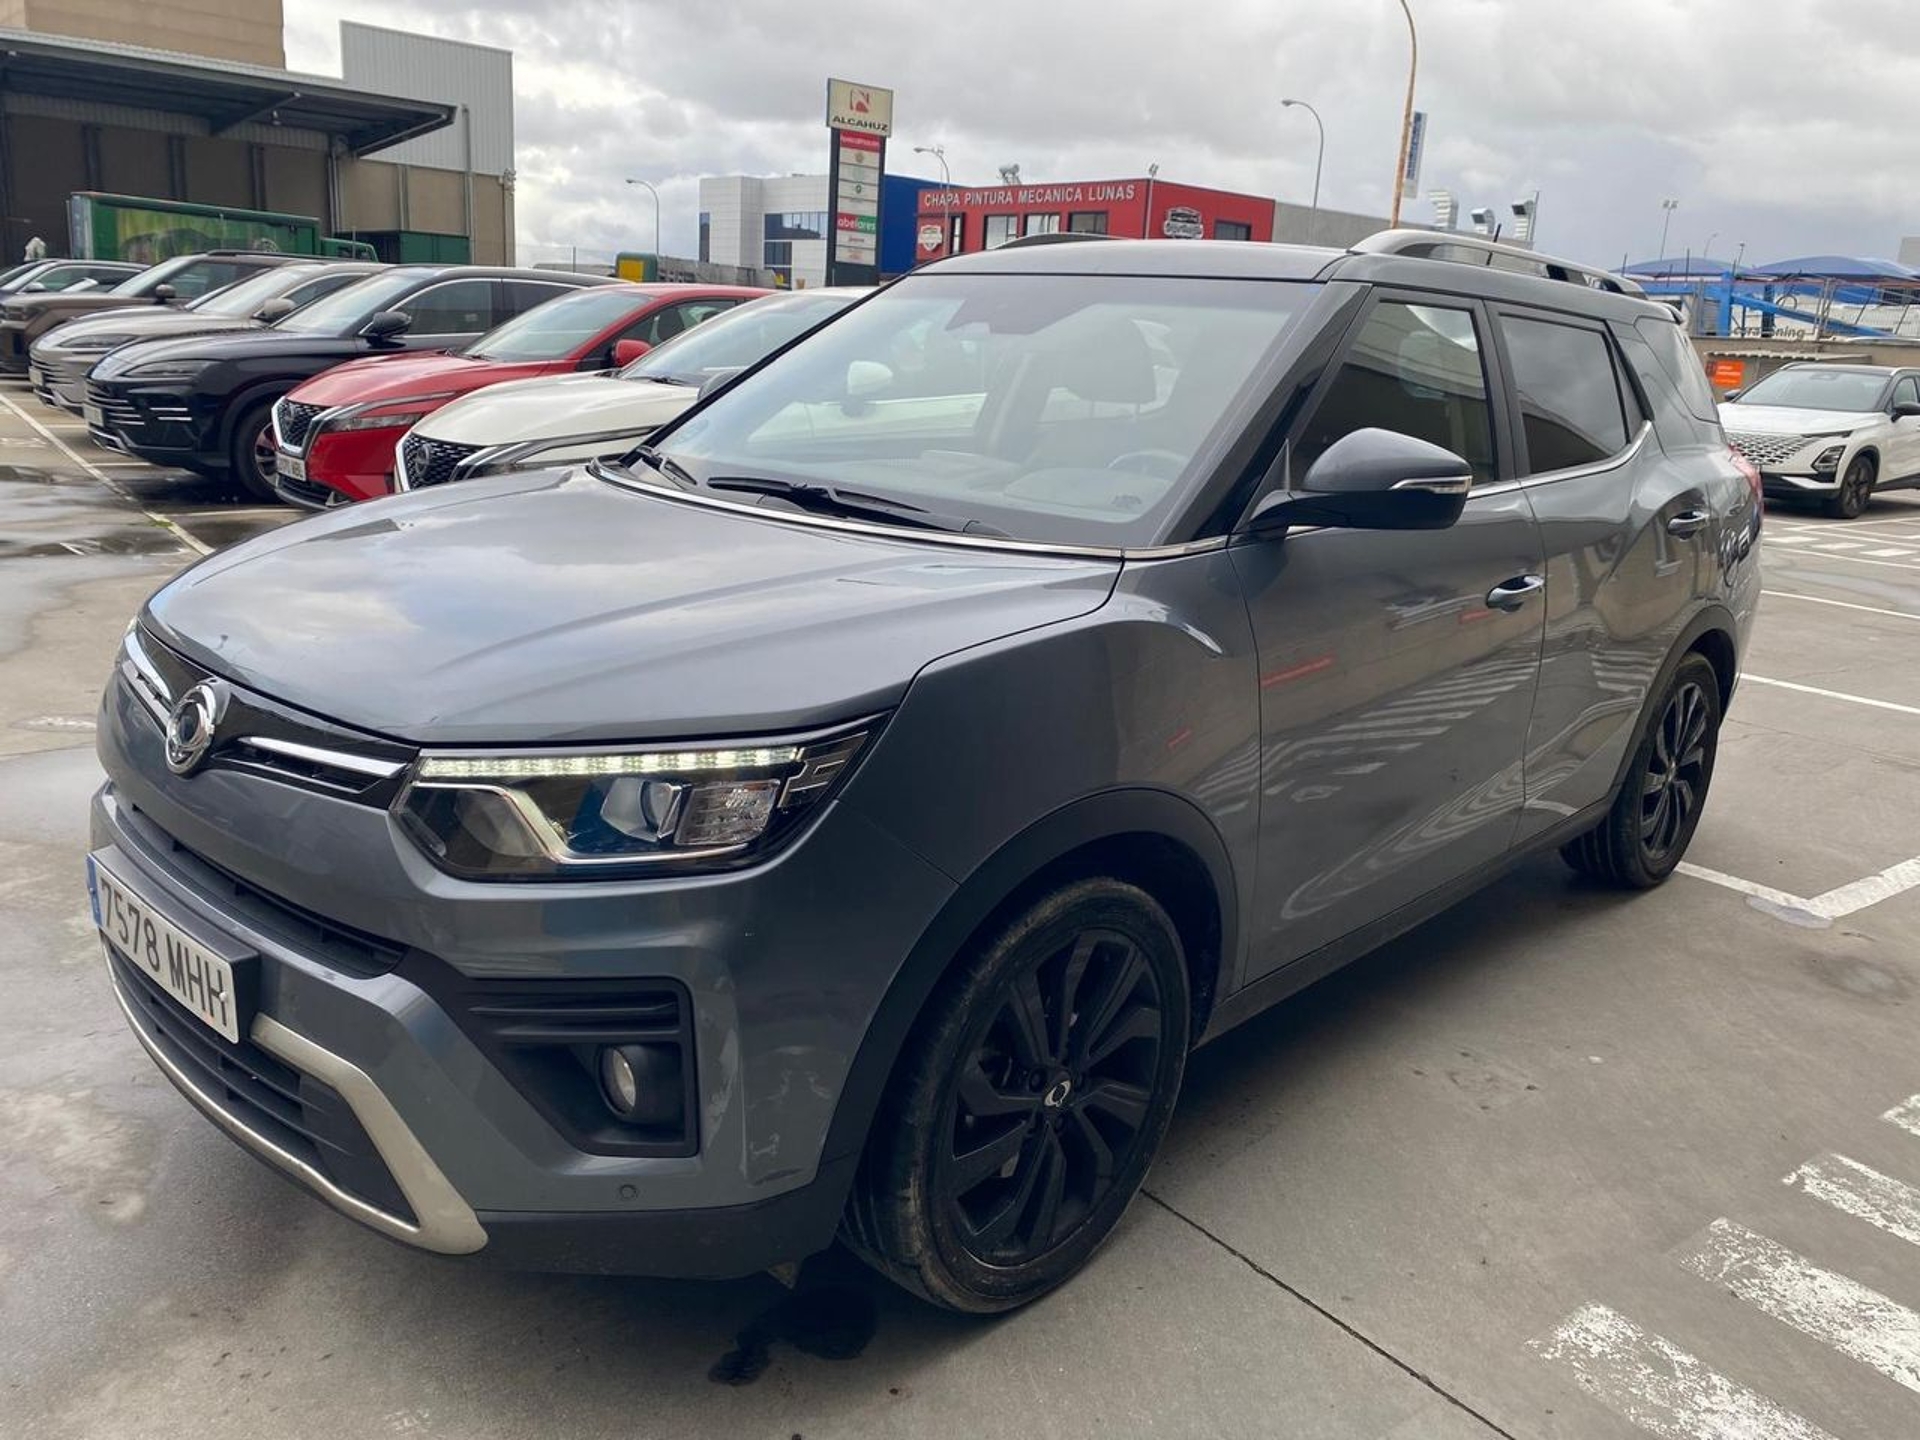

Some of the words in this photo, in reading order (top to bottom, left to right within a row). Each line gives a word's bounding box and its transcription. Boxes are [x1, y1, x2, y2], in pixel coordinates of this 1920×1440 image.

[832, 115, 888, 131] ALCAHUZ
[924, 192, 960, 207] CHAPA
[964, 190, 1013, 206] PINTURA
[1018, 186, 1082, 203] MECANICA
[1088, 184, 1135, 201] LUNAS
[101, 877, 160, 973] 7578
[165, 932, 227, 1027] MHH
